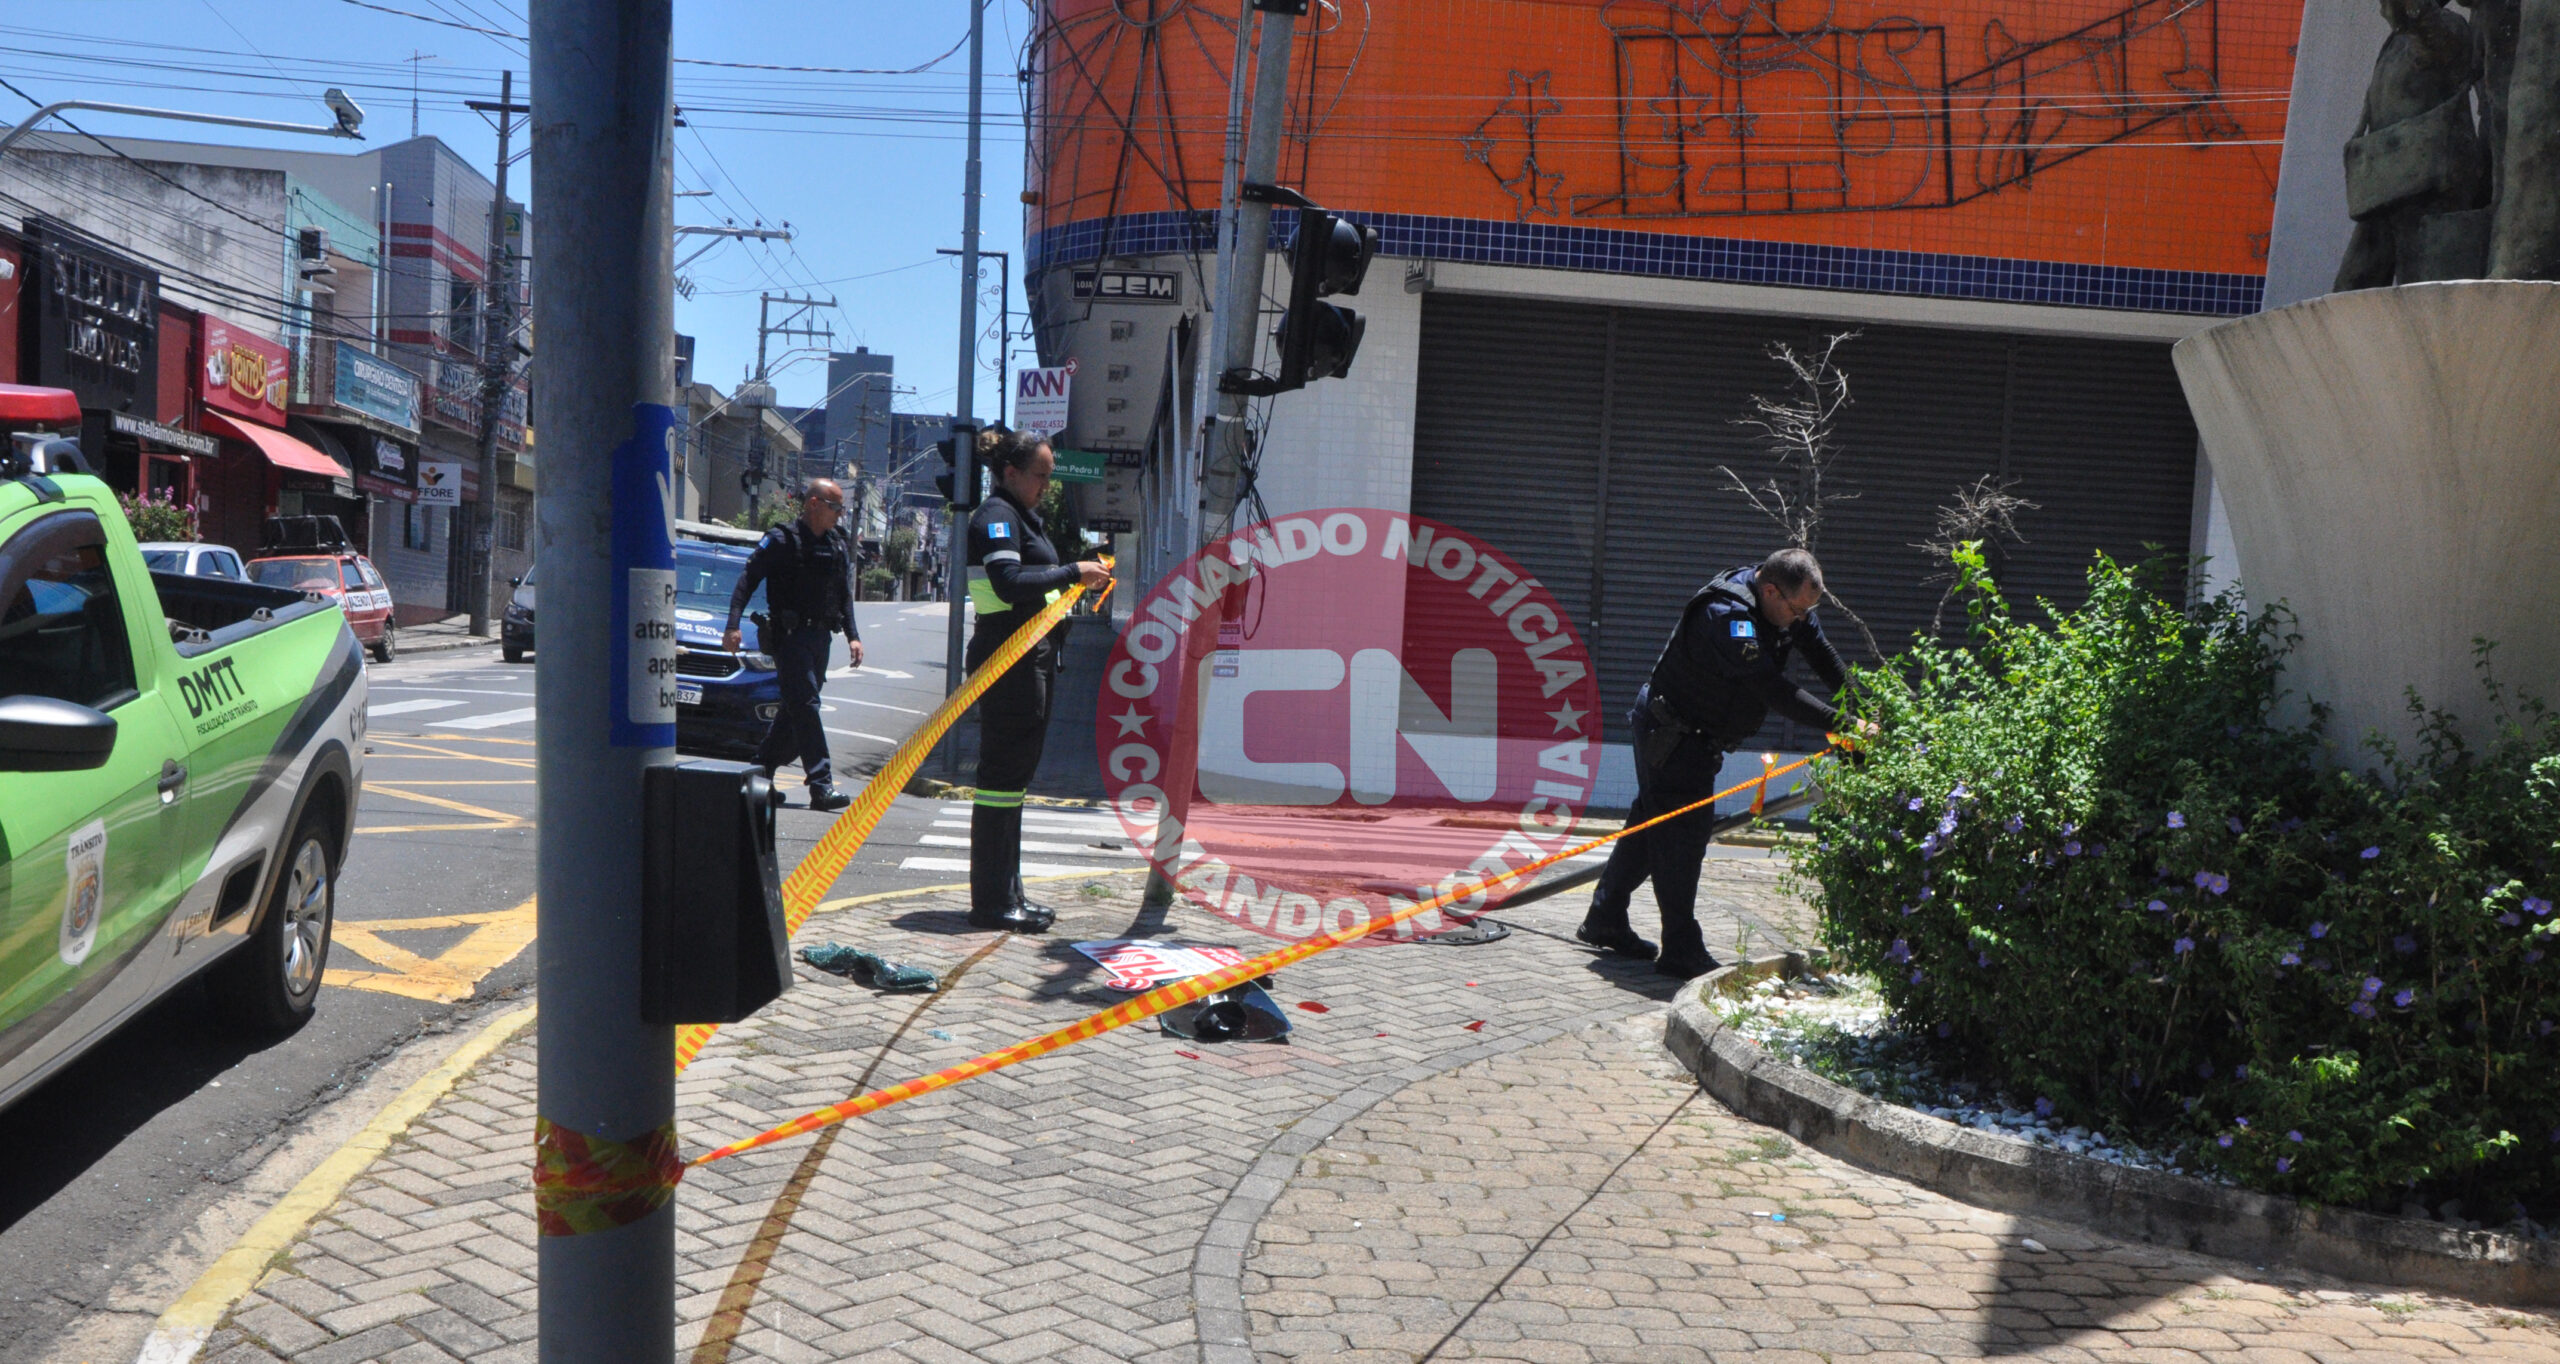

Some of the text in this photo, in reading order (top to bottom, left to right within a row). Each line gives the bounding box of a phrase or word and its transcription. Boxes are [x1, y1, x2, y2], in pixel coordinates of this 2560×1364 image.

[1102, 275, 1172, 297] CEM
[1019, 370, 1065, 398] KNN
[115, 415, 215, 454] www.stellaimoveis.com.br
[1069, 464, 1093, 475] Pedro
[177, 655, 245, 719] DMTT
[70, 832, 104, 860] TRÂNSITO
